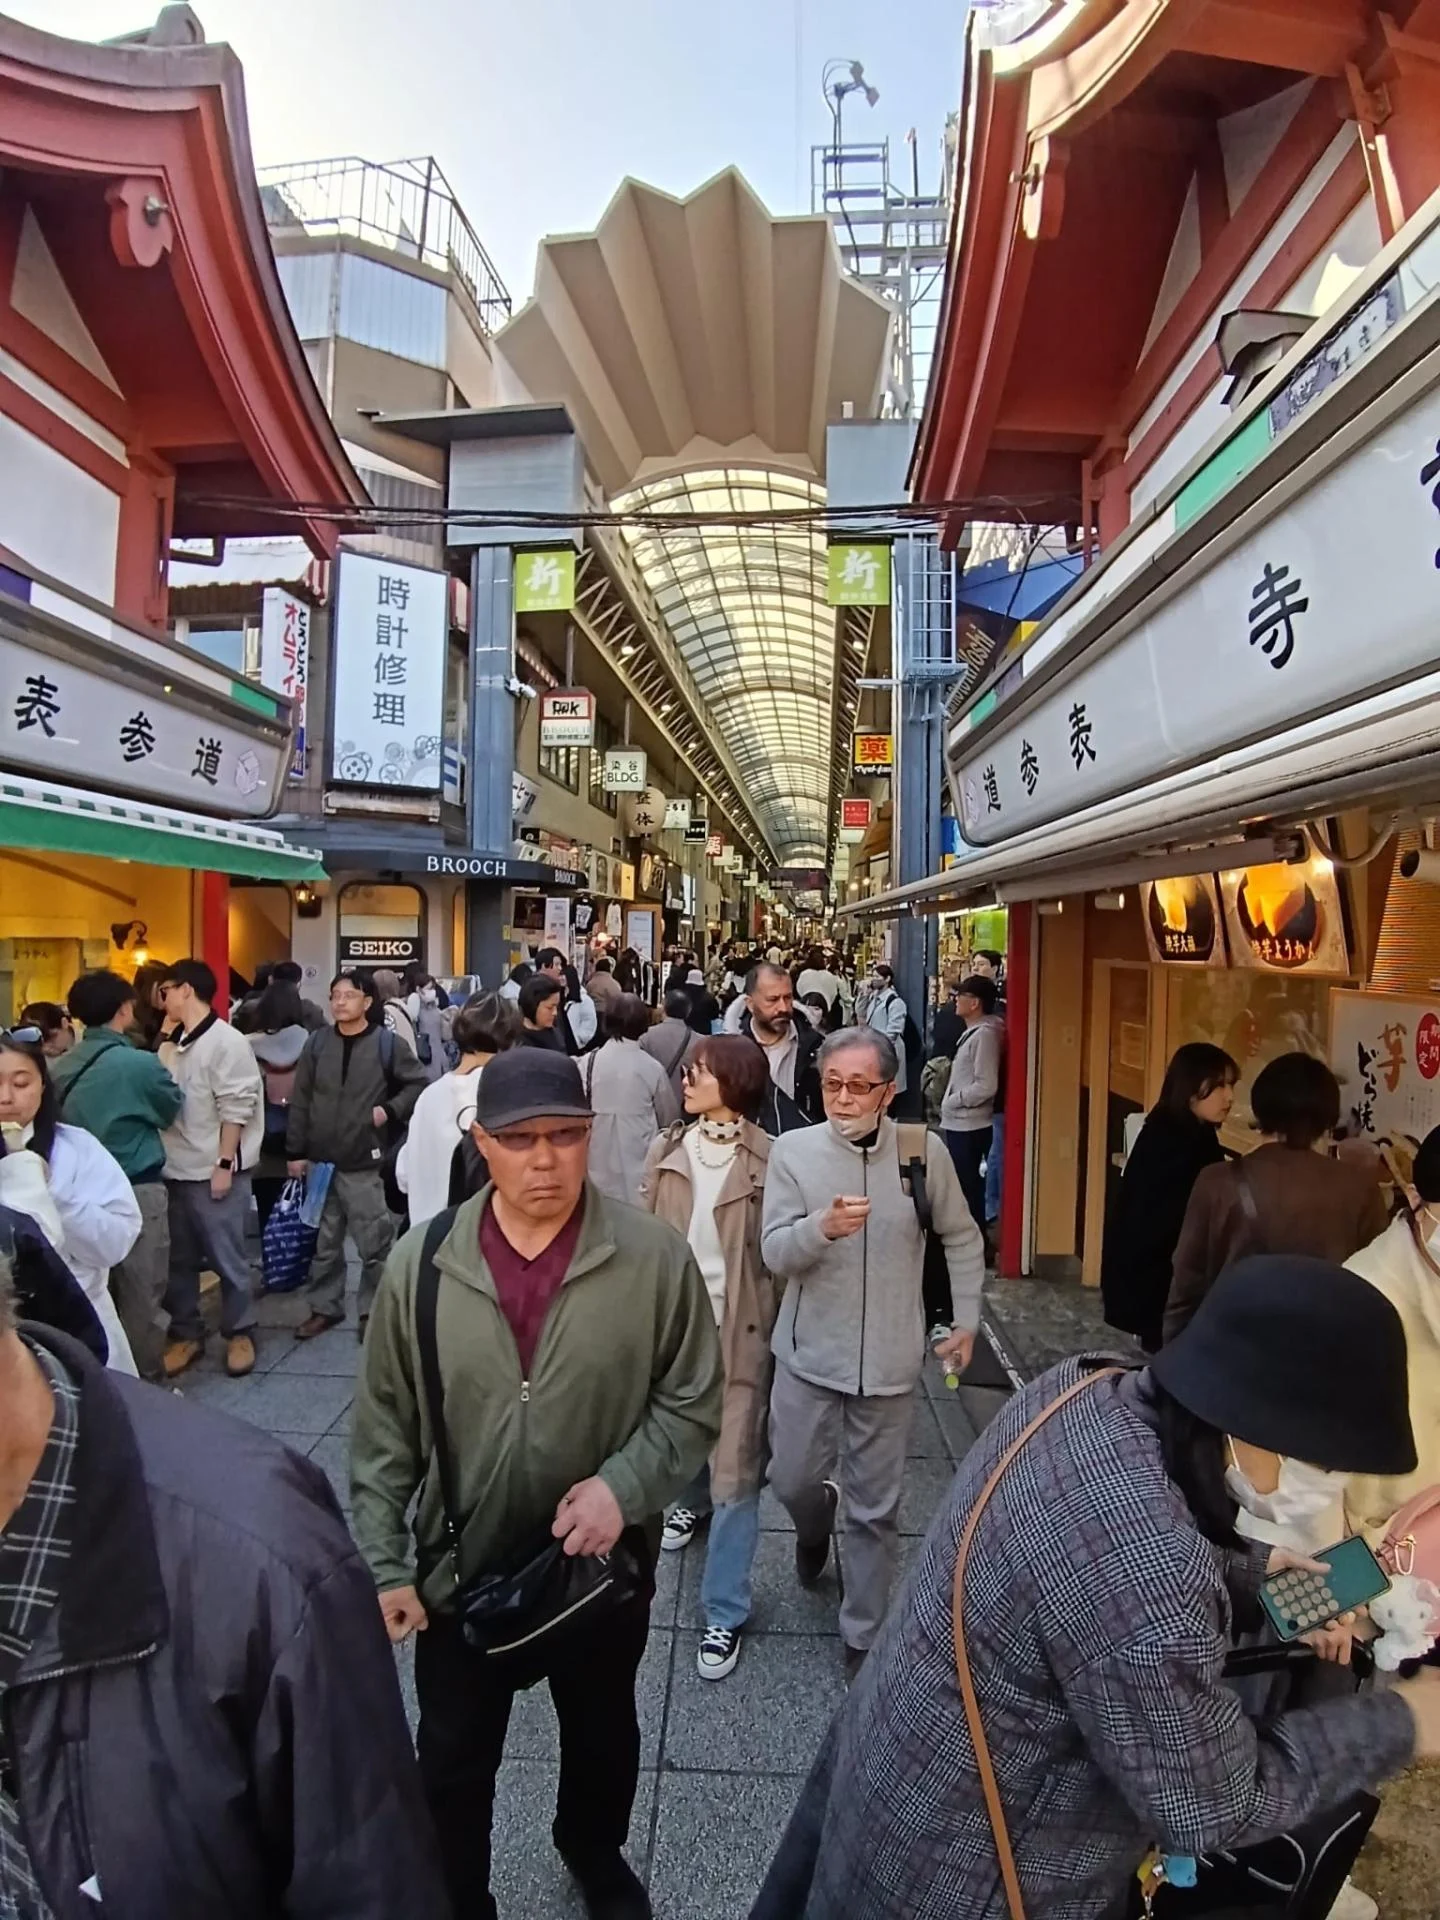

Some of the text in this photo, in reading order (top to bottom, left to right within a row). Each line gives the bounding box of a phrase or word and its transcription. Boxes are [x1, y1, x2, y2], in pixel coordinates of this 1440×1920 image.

[1248, 561, 1310, 669] 寺
[372, 575, 410, 727] 時計修理
[14, 675, 223, 786] 表参道
[860, 737, 888, 761] 薬
[607, 772, 642, 783] BLDG.
[426, 855, 507, 876] BROOCH
[348, 940, 413, 956] SEIKO
